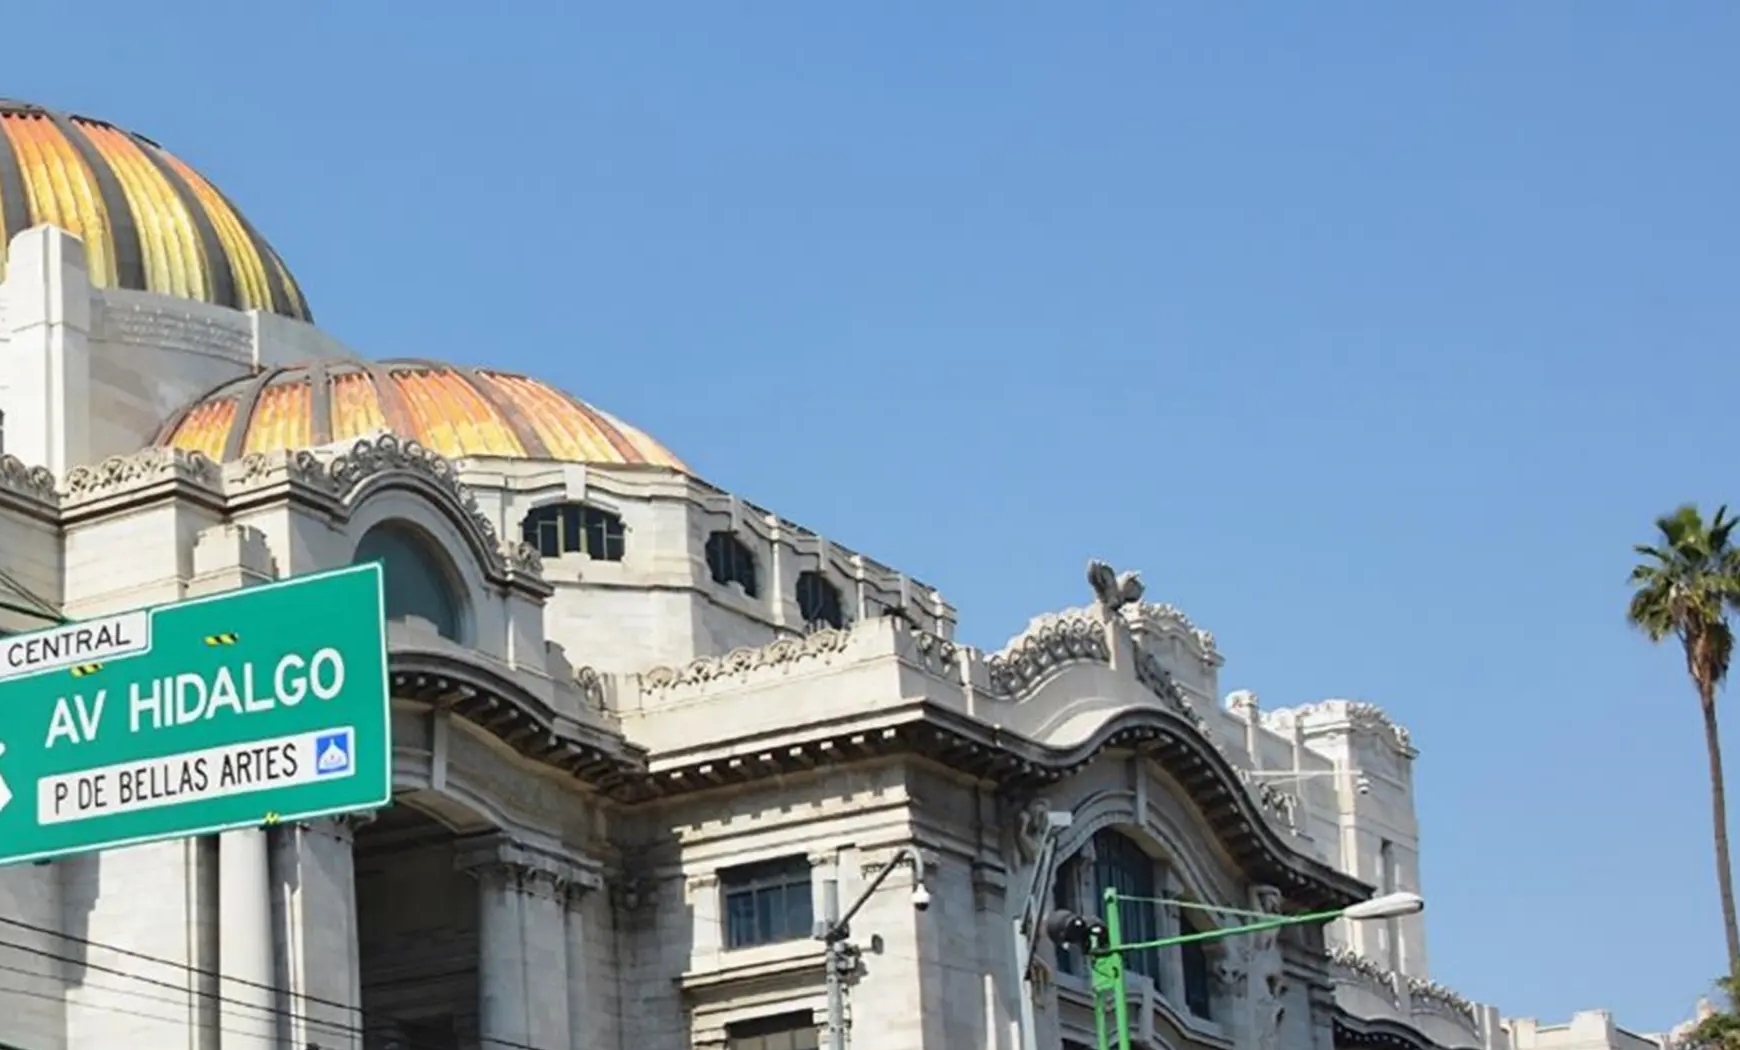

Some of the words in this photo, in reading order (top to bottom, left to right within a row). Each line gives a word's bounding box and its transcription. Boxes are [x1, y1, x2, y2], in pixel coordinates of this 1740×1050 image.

[7, 622, 132, 667] CENTRAL
[44, 689, 107, 748] AV
[129, 647, 345, 732] HIDALGO
[54, 782, 69, 815] P
[77, 775, 108, 810] DE
[119, 757, 209, 804] BELLAS
[219, 742, 299, 788] ARTES
